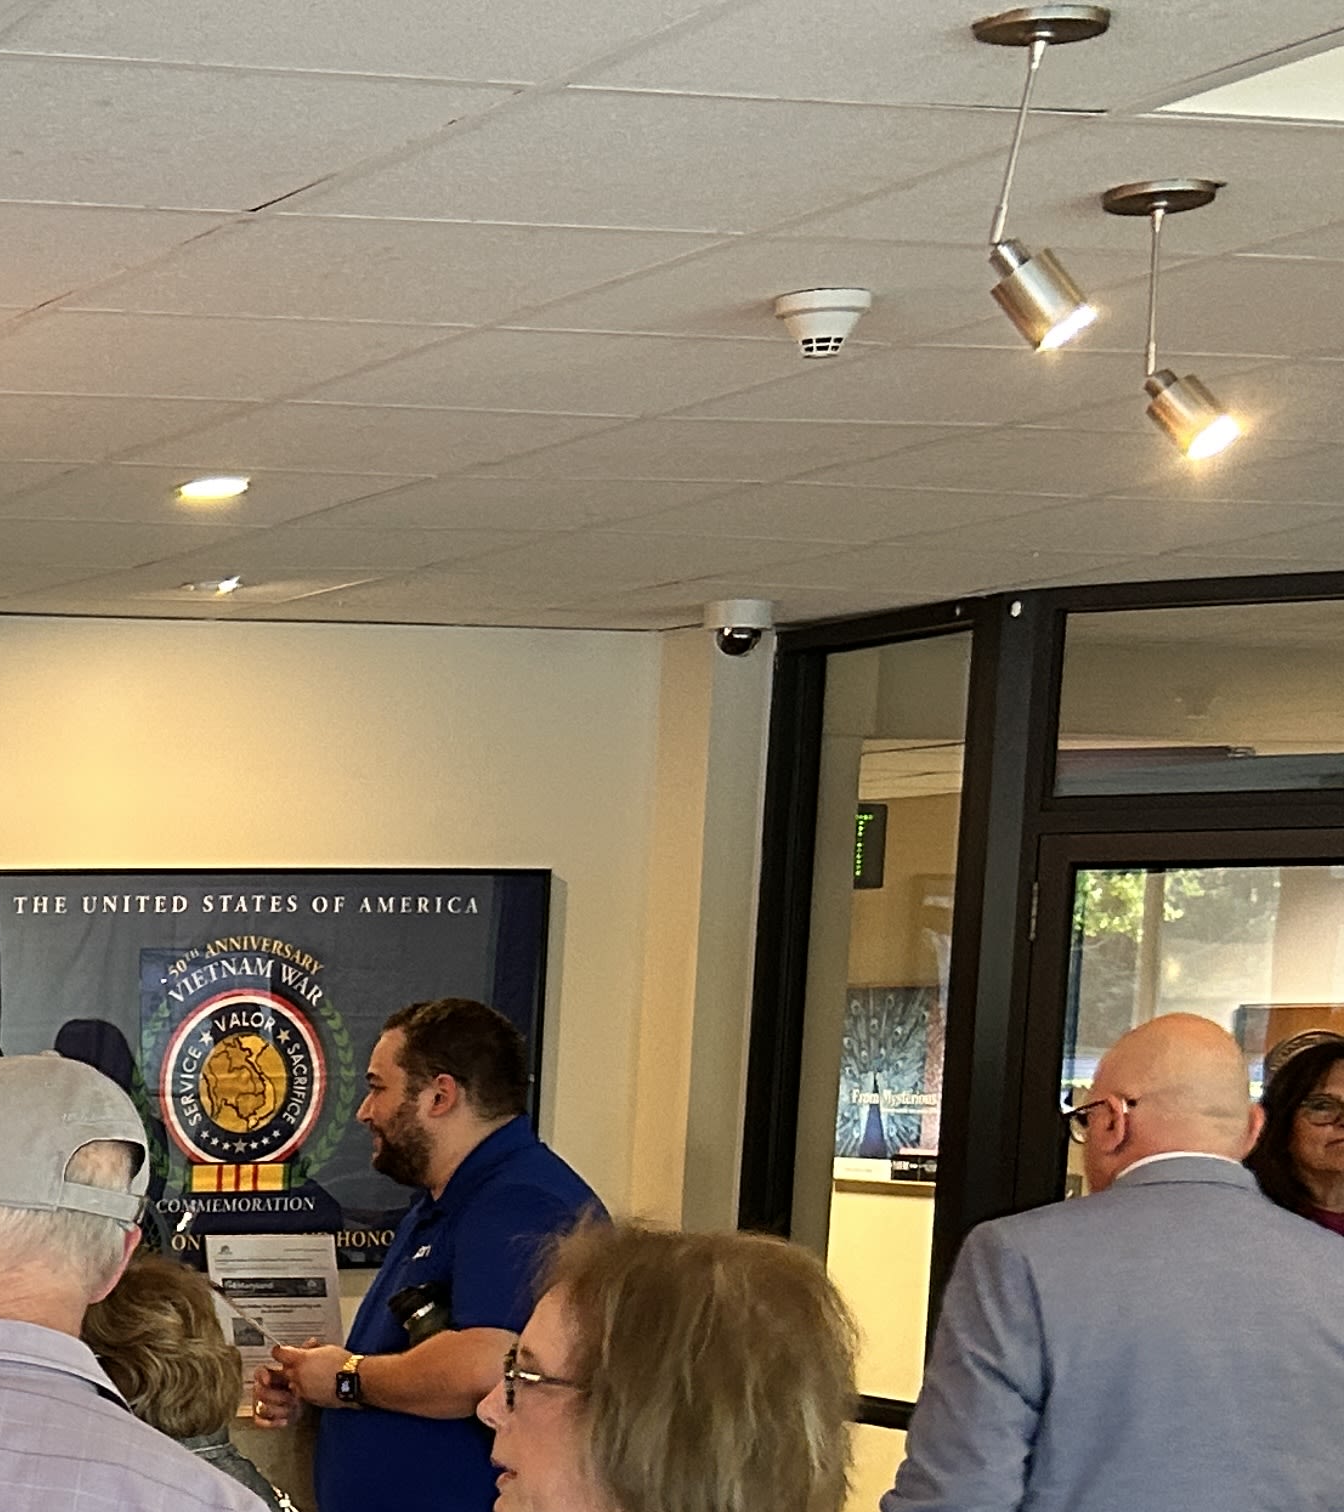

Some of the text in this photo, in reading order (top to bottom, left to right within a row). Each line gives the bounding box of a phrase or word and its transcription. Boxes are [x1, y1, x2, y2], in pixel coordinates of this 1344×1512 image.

[13, 895, 479, 915] THE UNITED STATES OF AMERICA
[205, 935, 325, 976] ANNIVERSARY
[167, 957, 324, 1007] VIETNAM WAR
[213, 1011, 276, 1034] VALOR
[179, 1045, 203, 1127] SERVICE
[282, 1043, 309, 1126] SACRIFICE
[852, 1089, 880, 1104] From
[156, 1196, 316, 1214] COMMEMORATION
